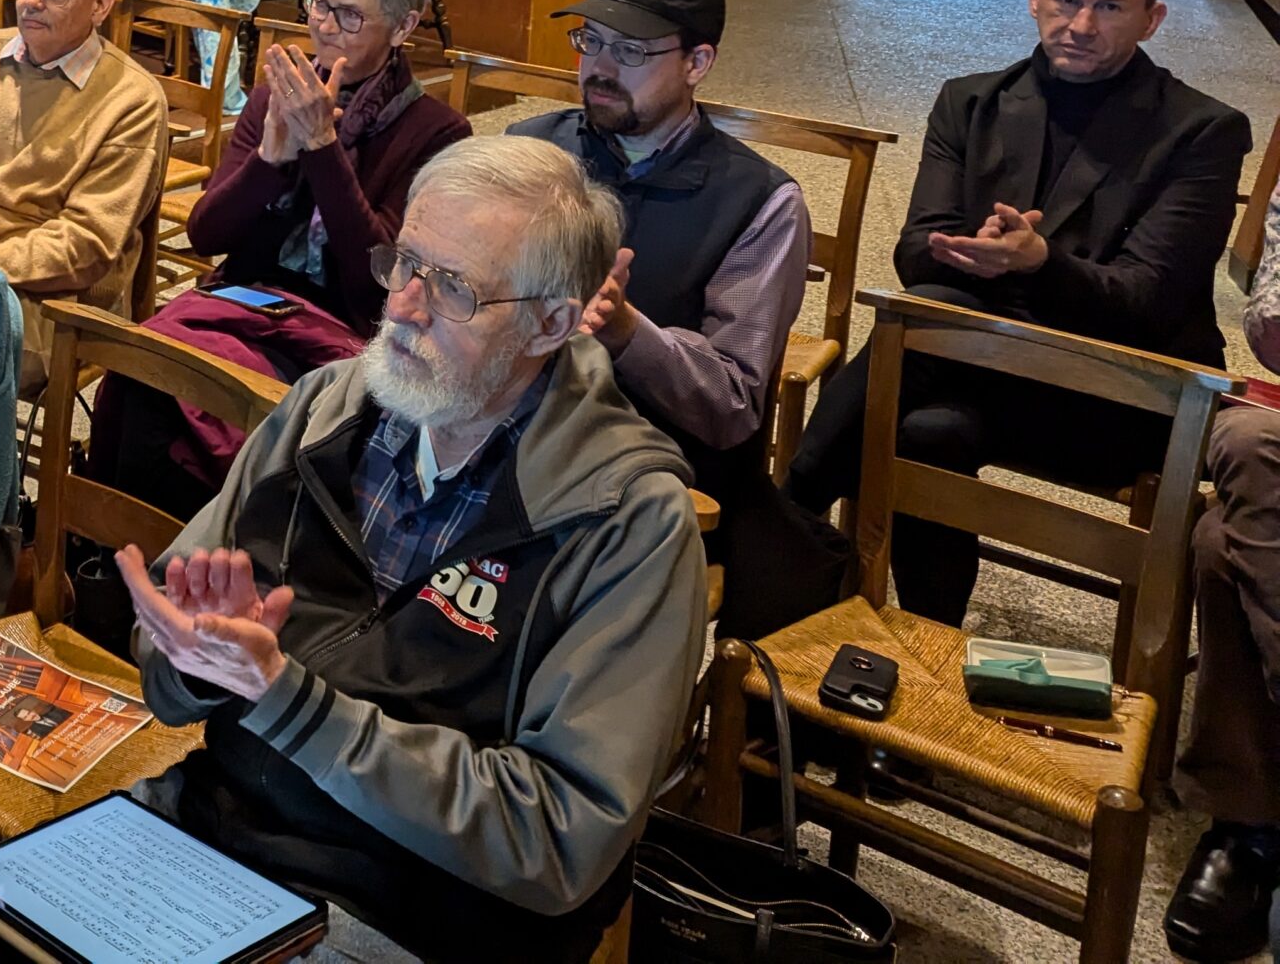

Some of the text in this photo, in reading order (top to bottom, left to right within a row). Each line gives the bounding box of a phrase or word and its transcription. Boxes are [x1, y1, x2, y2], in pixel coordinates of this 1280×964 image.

[478, 559, 505, 578] AC
[430, 562, 498, 617] 50
[450, 611, 468, 626] 2018
